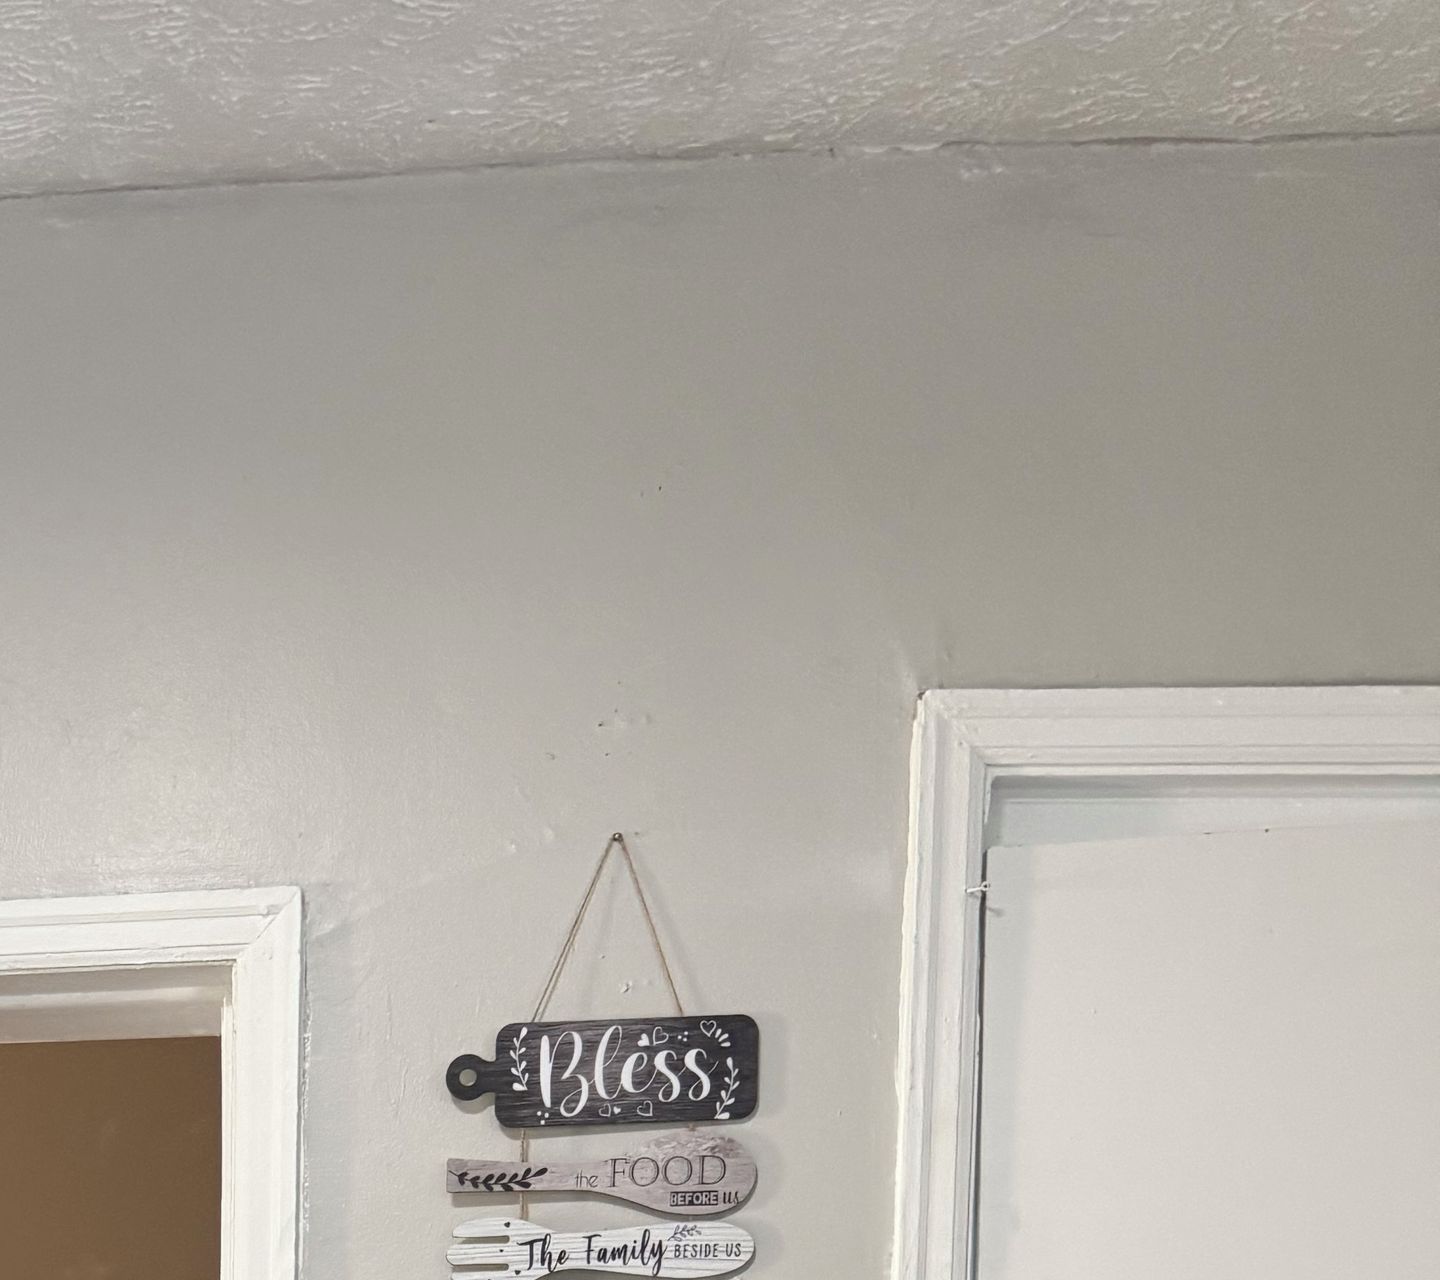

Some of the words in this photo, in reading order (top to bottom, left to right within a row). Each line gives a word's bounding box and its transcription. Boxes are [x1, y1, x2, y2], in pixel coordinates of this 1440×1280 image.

[540, 1025, 718, 1117] Bless
[574, 1169, 599, 1188] the
[604, 1155, 726, 1188] FOOD
[670, 1191, 719, 1206] BEFORE
[723, 1190, 739, 1205] us
[517, 1232, 569, 1272] The
[583, 1229, 668, 1277] Family
[674, 1242, 719, 1258] BESIDE
[725, 1242, 742, 1257] US
